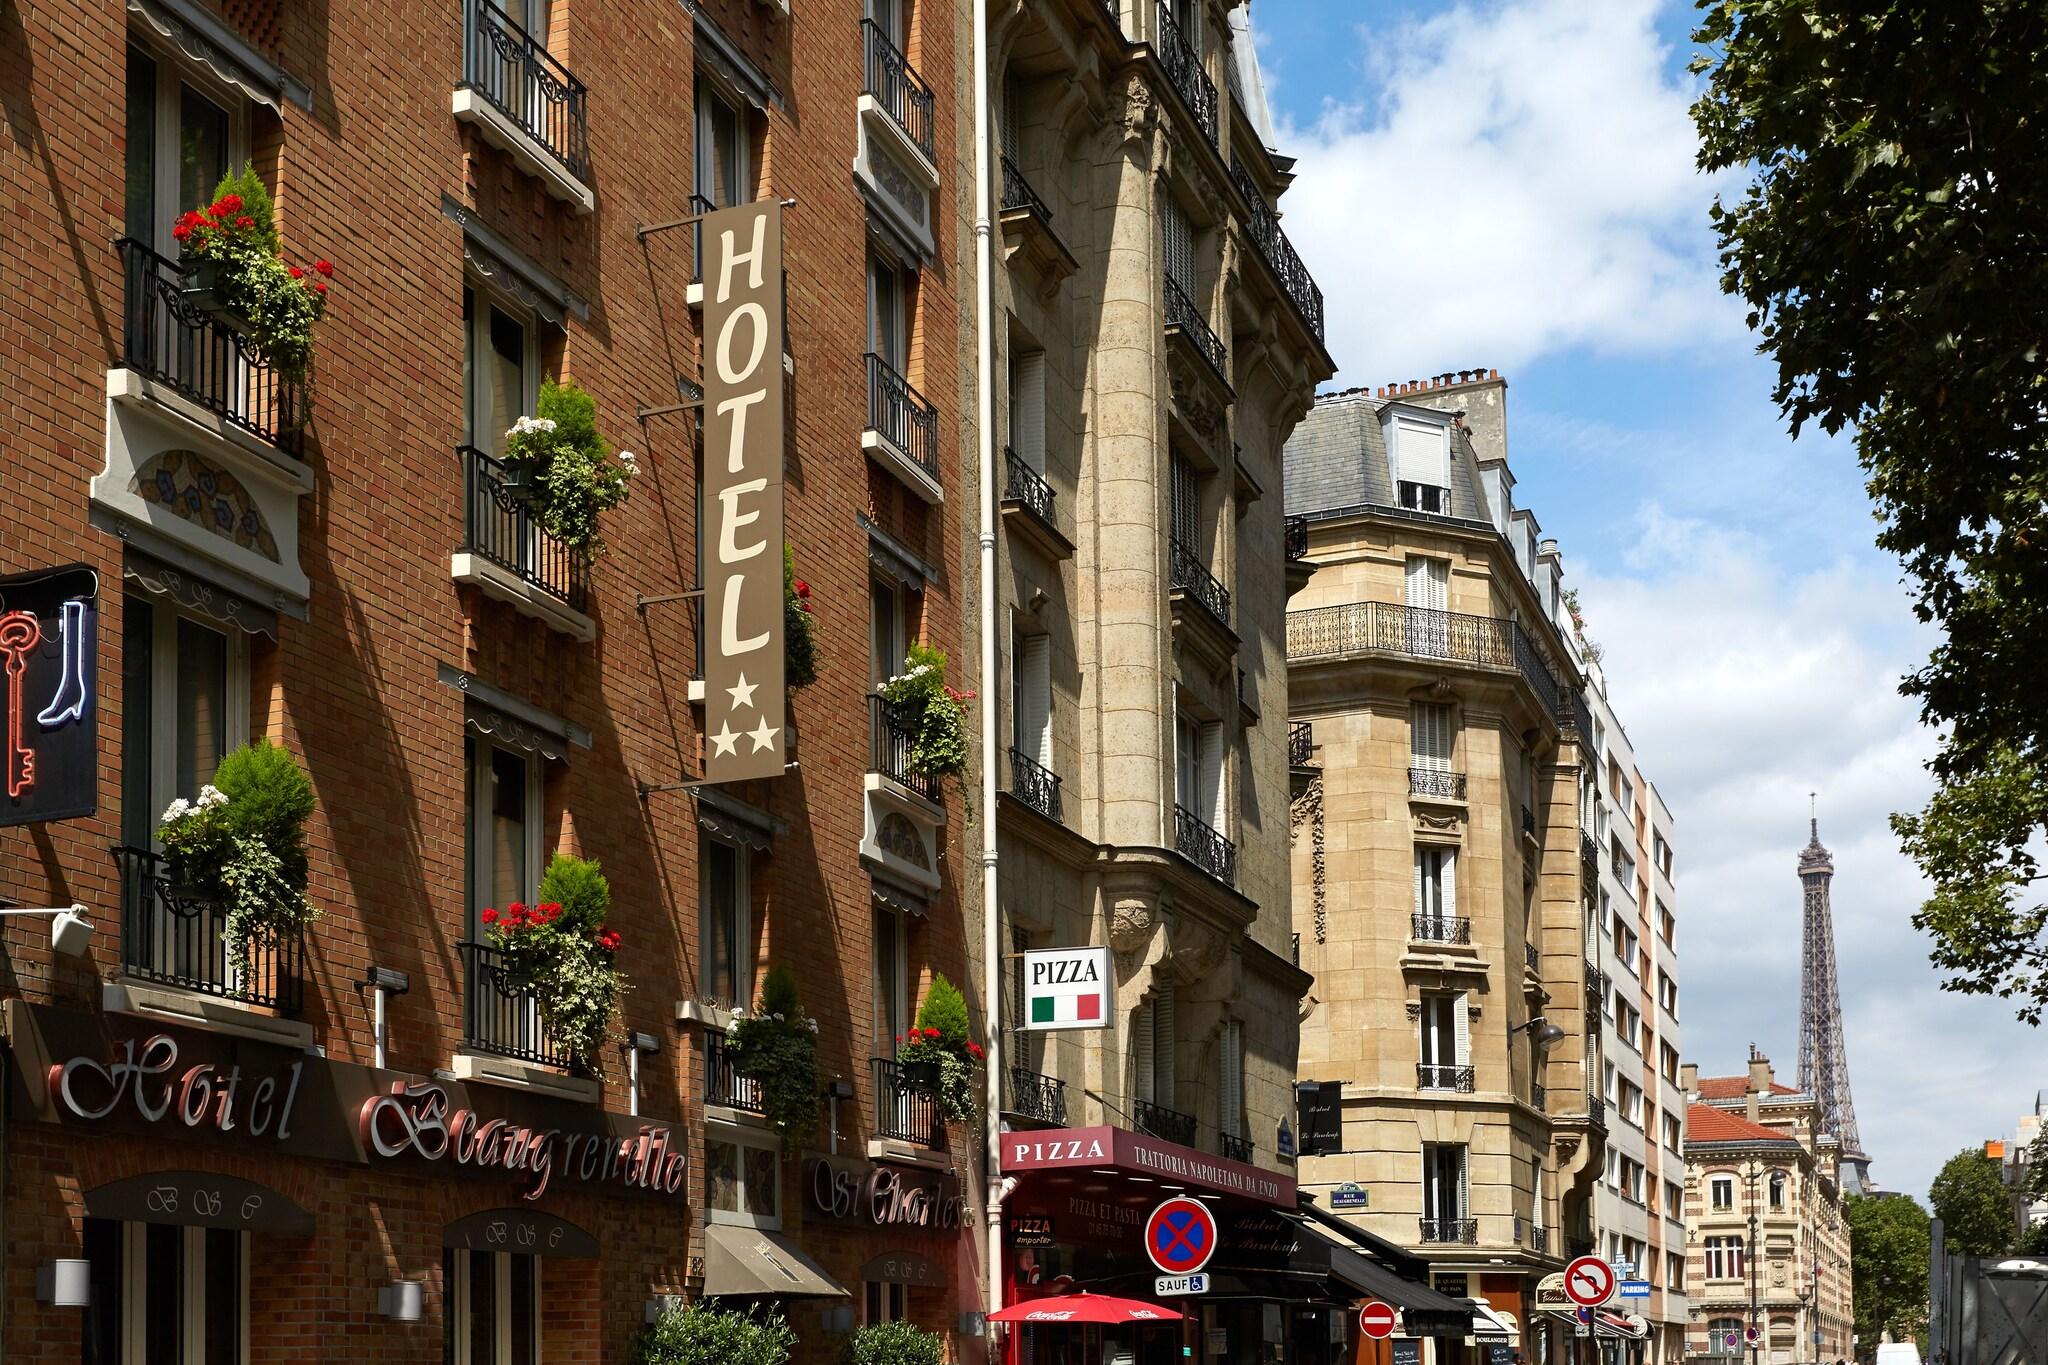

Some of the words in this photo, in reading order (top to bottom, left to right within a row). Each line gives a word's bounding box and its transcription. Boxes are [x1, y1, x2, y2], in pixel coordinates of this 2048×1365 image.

[715, 214, 769, 658] HOTEL
[1032, 959, 1099, 986] PIZZA
[48, 1033, 303, 1140] Hotel
[359, 1080, 686, 1200] Beaugrenelle
[1014, 1139, 1105, 1162] PIZZA
[1134, 1146, 1187, 1175] TRATTORIA
[1190, 1161, 1243, 1190] NAPOLETANA
[1246, 1176, 1256, 1193] DA
[1259, 1180, 1278, 1199] ENZO
[870, 1167, 963, 1230] Charles
[1070, 1197, 1096, 1217] PIZZA
[1100, 1203, 1111, 1220] ET
[1115, 1206, 1140, 1225] PASTA
[1010, 1219, 1051, 1233] PIZZA
[1016, 1235, 1052, 1246] emporter
[1158, 1279, 1188, 1292] SAUF
[1621, 1286, 1649, 1294] PARKING
